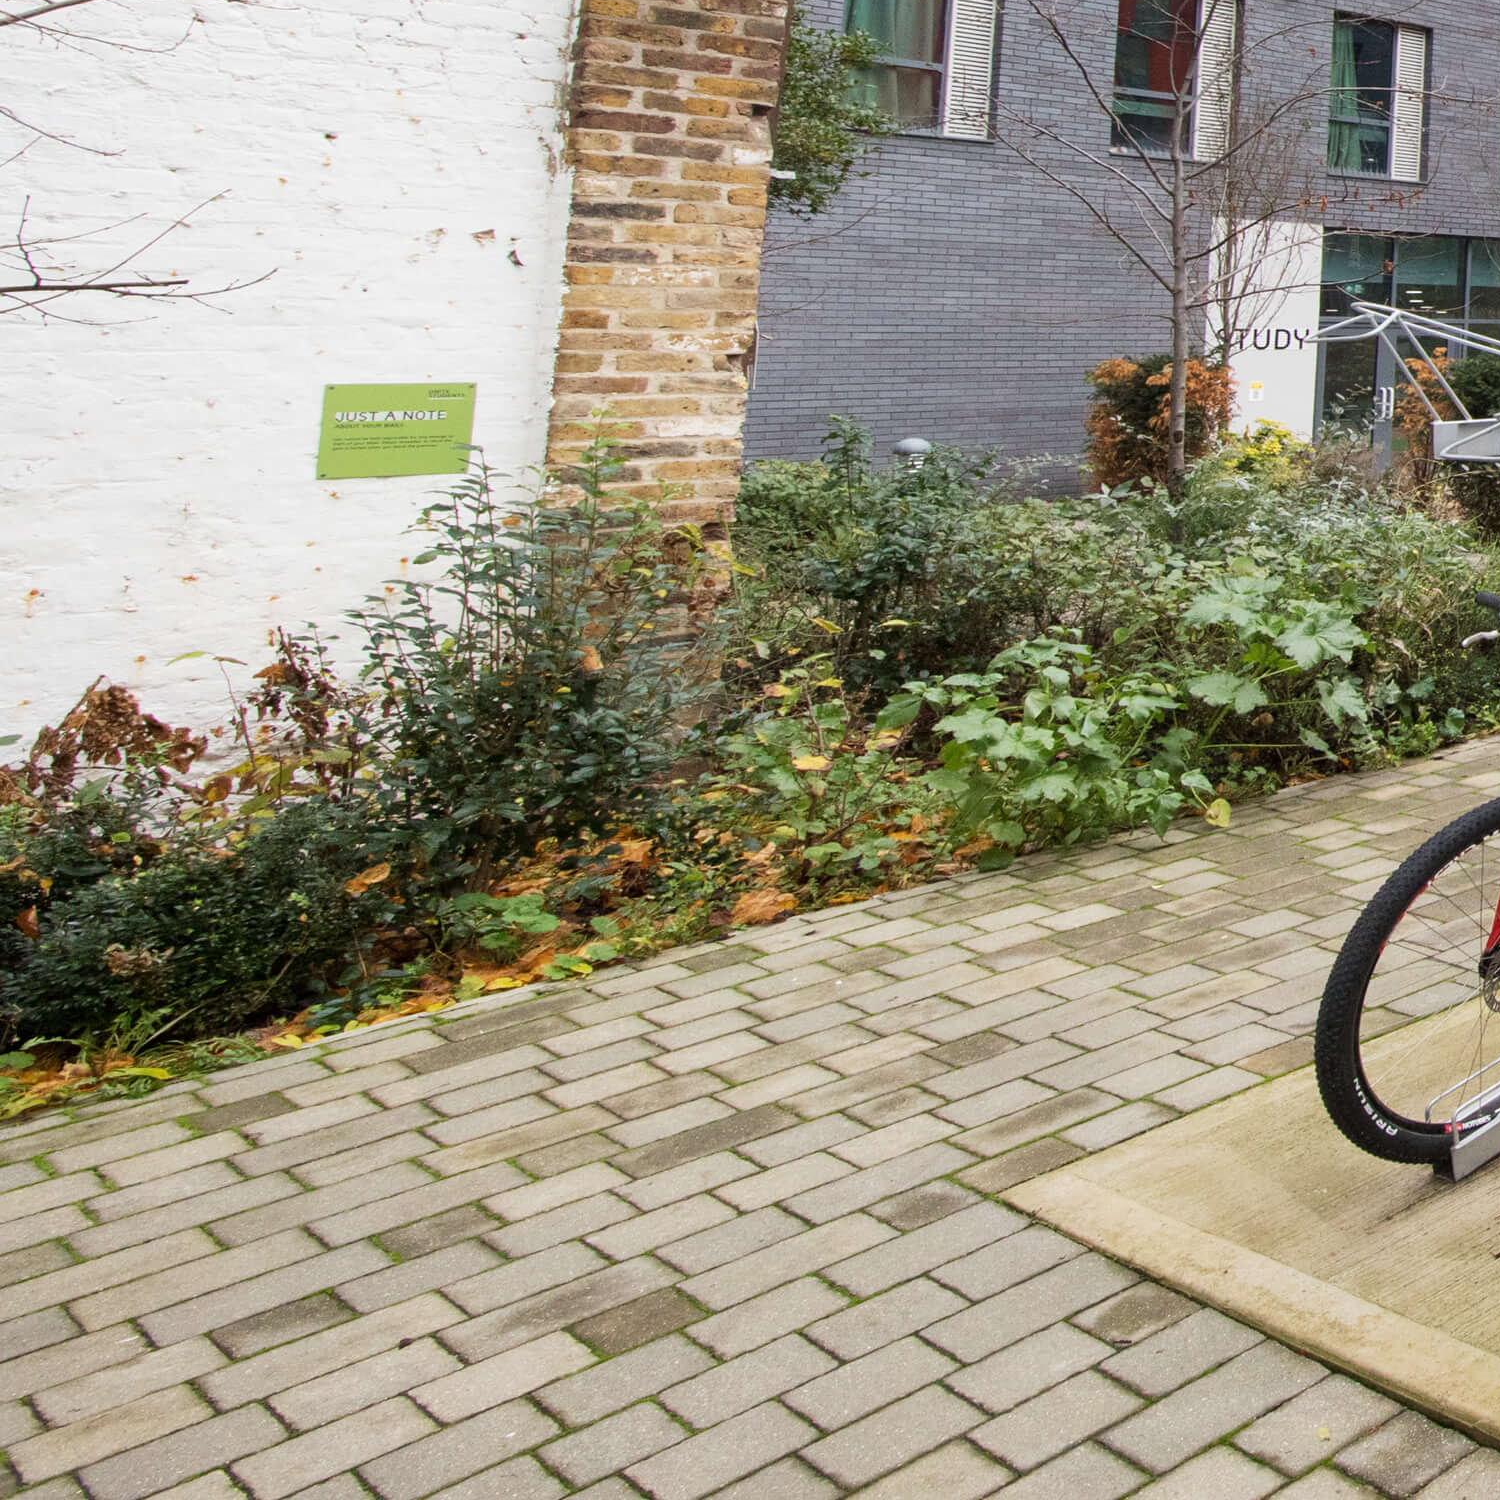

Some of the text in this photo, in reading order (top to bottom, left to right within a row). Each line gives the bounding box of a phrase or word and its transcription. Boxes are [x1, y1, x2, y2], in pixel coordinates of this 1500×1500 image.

[335, 410, 446, 422] JUST A NOTE
[1353, 1077, 1399, 1137] ARISUN
